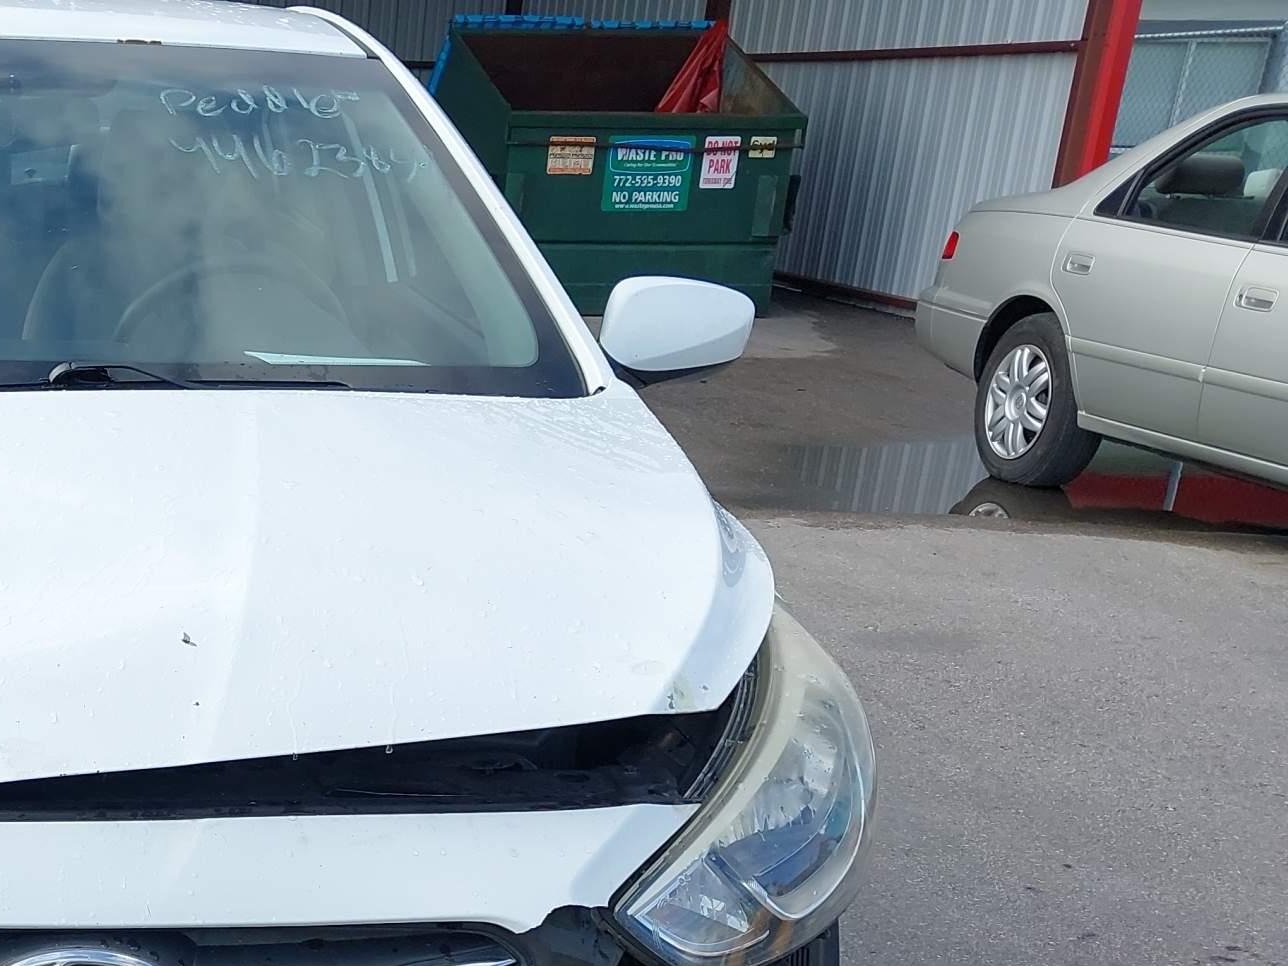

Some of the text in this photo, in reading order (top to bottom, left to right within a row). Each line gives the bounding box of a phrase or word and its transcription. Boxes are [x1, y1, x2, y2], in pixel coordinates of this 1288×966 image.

[617, 147, 657, 161] WASTE
[706, 140, 739, 156] DO NOT
[707, 159, 732, 175] PARK
[613, 175, 682, 187] 772-595-9390
[612, 191, 680, 203] NO PARKING
